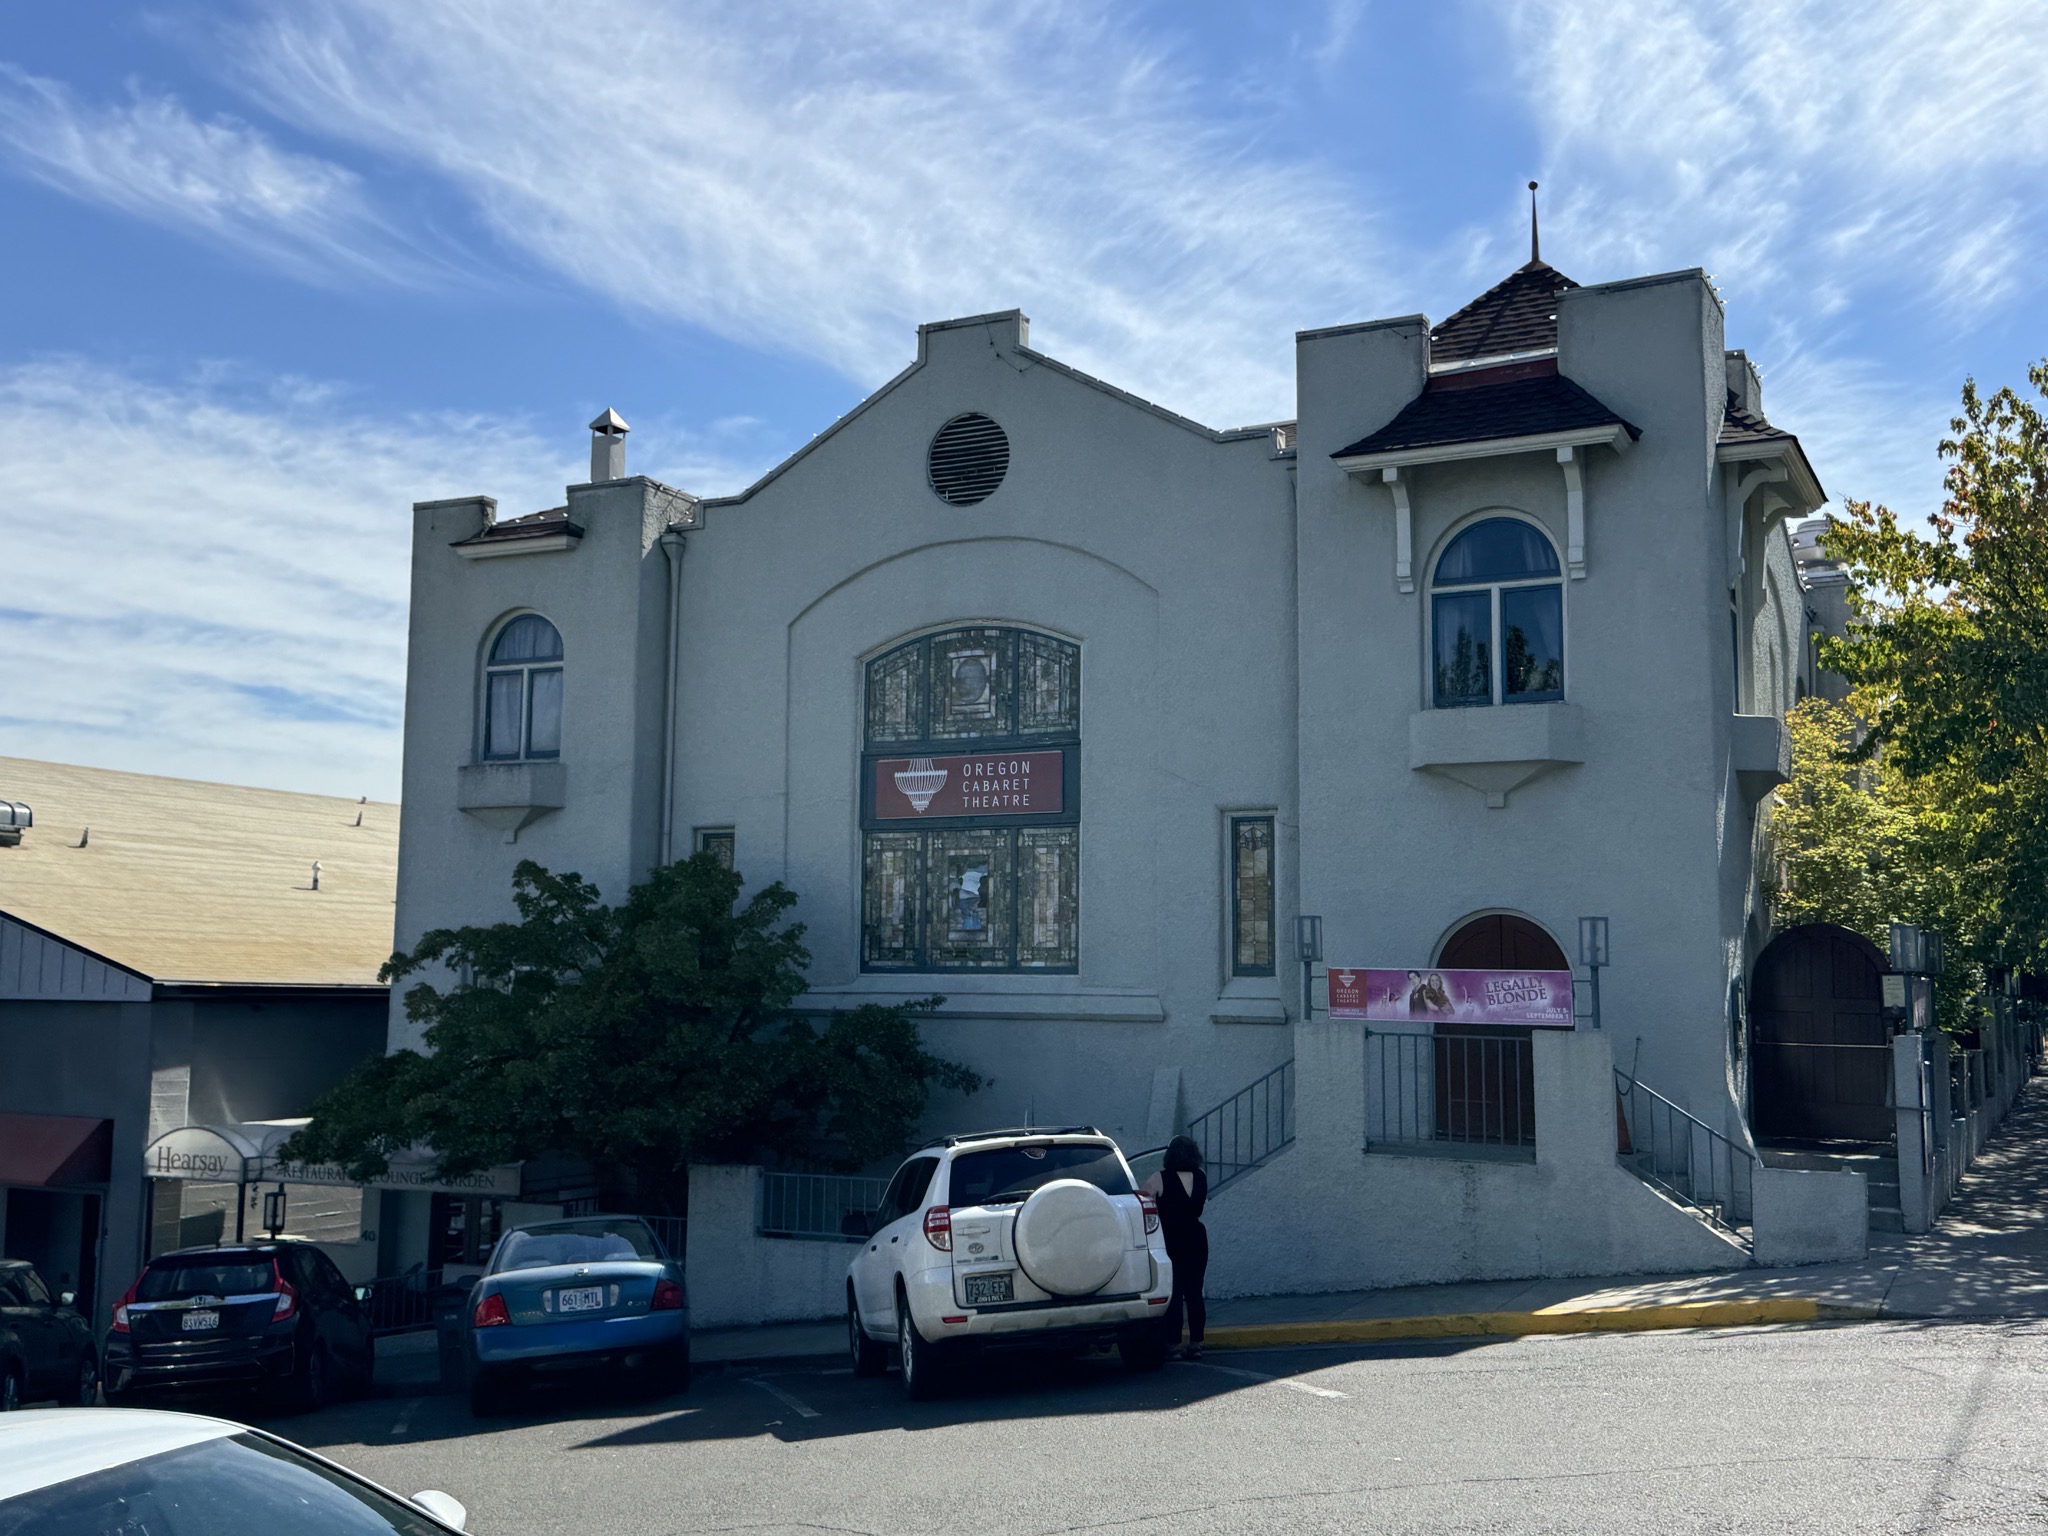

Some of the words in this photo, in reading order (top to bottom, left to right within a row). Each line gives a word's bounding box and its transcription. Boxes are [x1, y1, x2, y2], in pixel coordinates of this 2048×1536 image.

[963, 761, 1030, 777] OREGON
[962, 778, 1030, 793] CABARET
[962, 794, 1030, 808] THEATRE
[1485, 977, 1543, 993] LEGALLY
[1487, 988, 1547, 1006] BLONDE
[156, 1146, 229, 1177] Hearsay
[361, 1230, 376, 1242] 40
[968, 1282, 987, 1297] 732
[561, 1294, 578, 1306] 661
[583, 1291, 599, 1304] MTL
